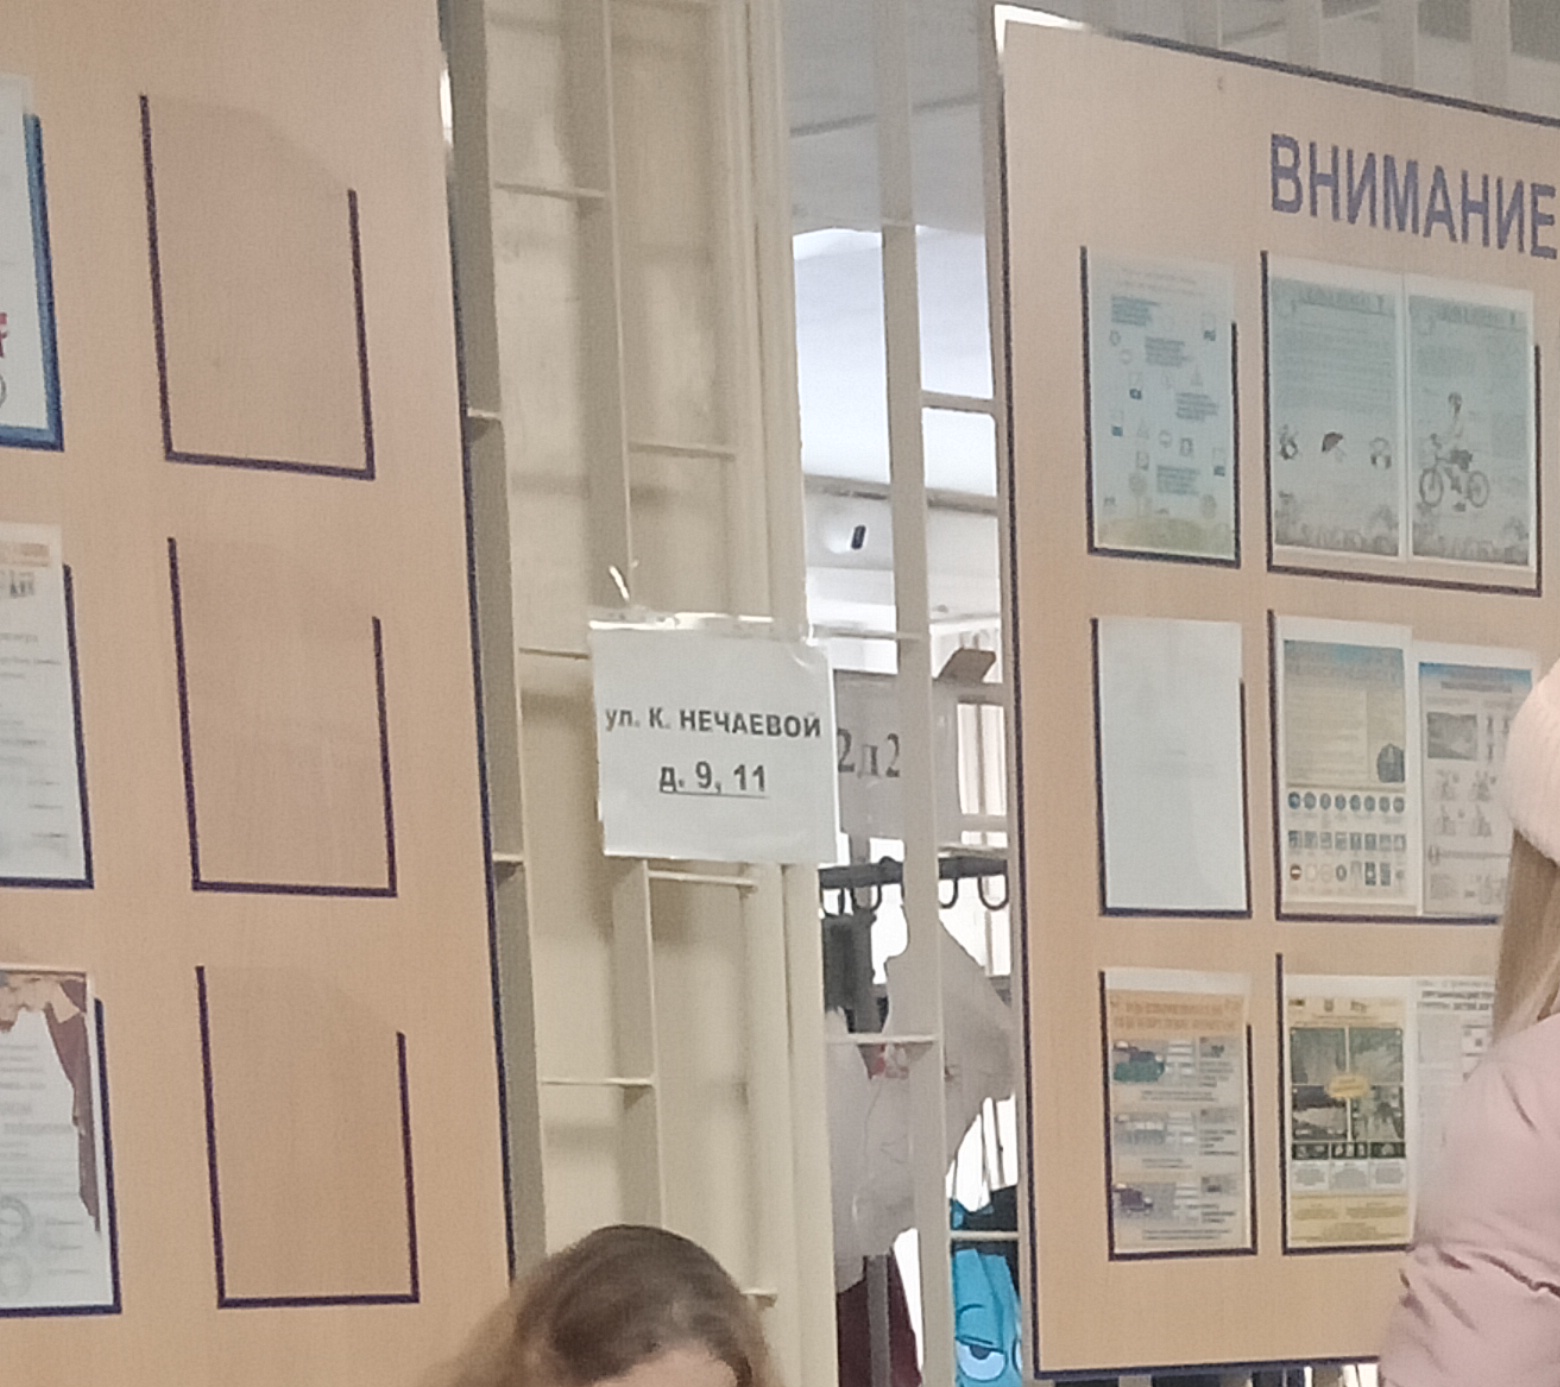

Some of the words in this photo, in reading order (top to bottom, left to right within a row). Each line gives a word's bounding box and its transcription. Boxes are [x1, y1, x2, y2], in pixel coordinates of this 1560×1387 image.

[605, 707, 641, 731] ул.
[648, 706, 672, 730] К.
[679, 708, 822, 739] НЕЧАЕВОЙ
[659, 765, 685, 793] д.
[694, 760, 722, 794] 9,
[732, 763, 767, 793] 11
